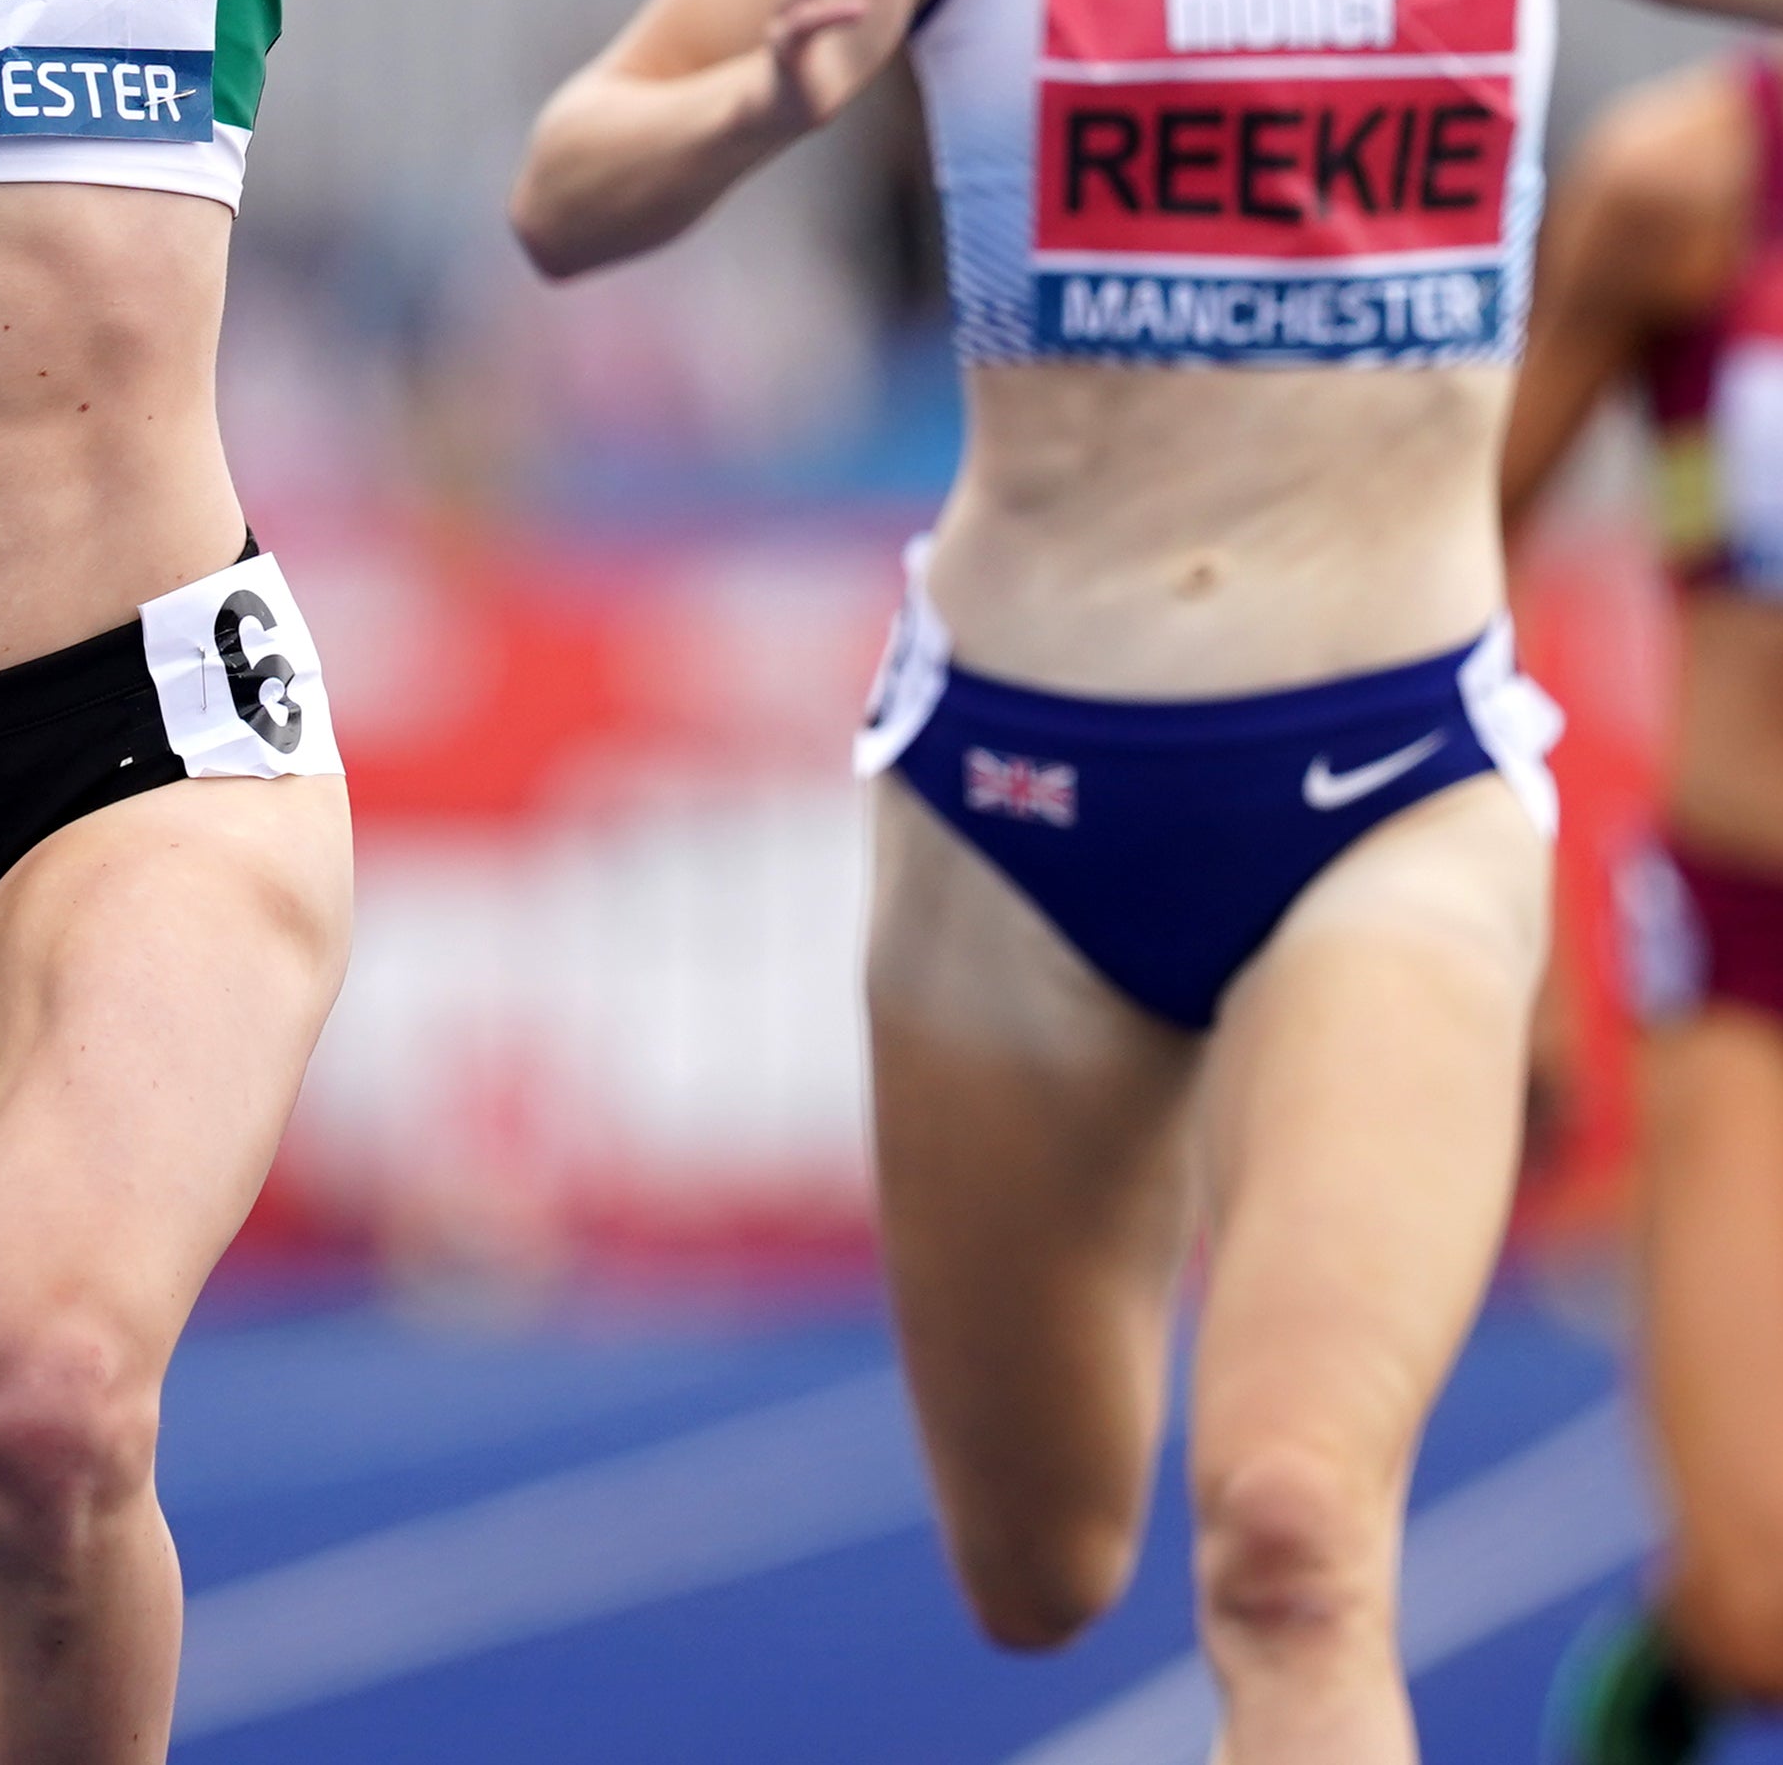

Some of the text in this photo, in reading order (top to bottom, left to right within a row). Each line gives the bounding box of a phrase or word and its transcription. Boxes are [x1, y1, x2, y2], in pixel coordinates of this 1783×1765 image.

[1062, 101, 1494, 225] REEKIE
[1061, 272, 1488, 346] MANCHESTER
[214, 589, 304, 756] 6
